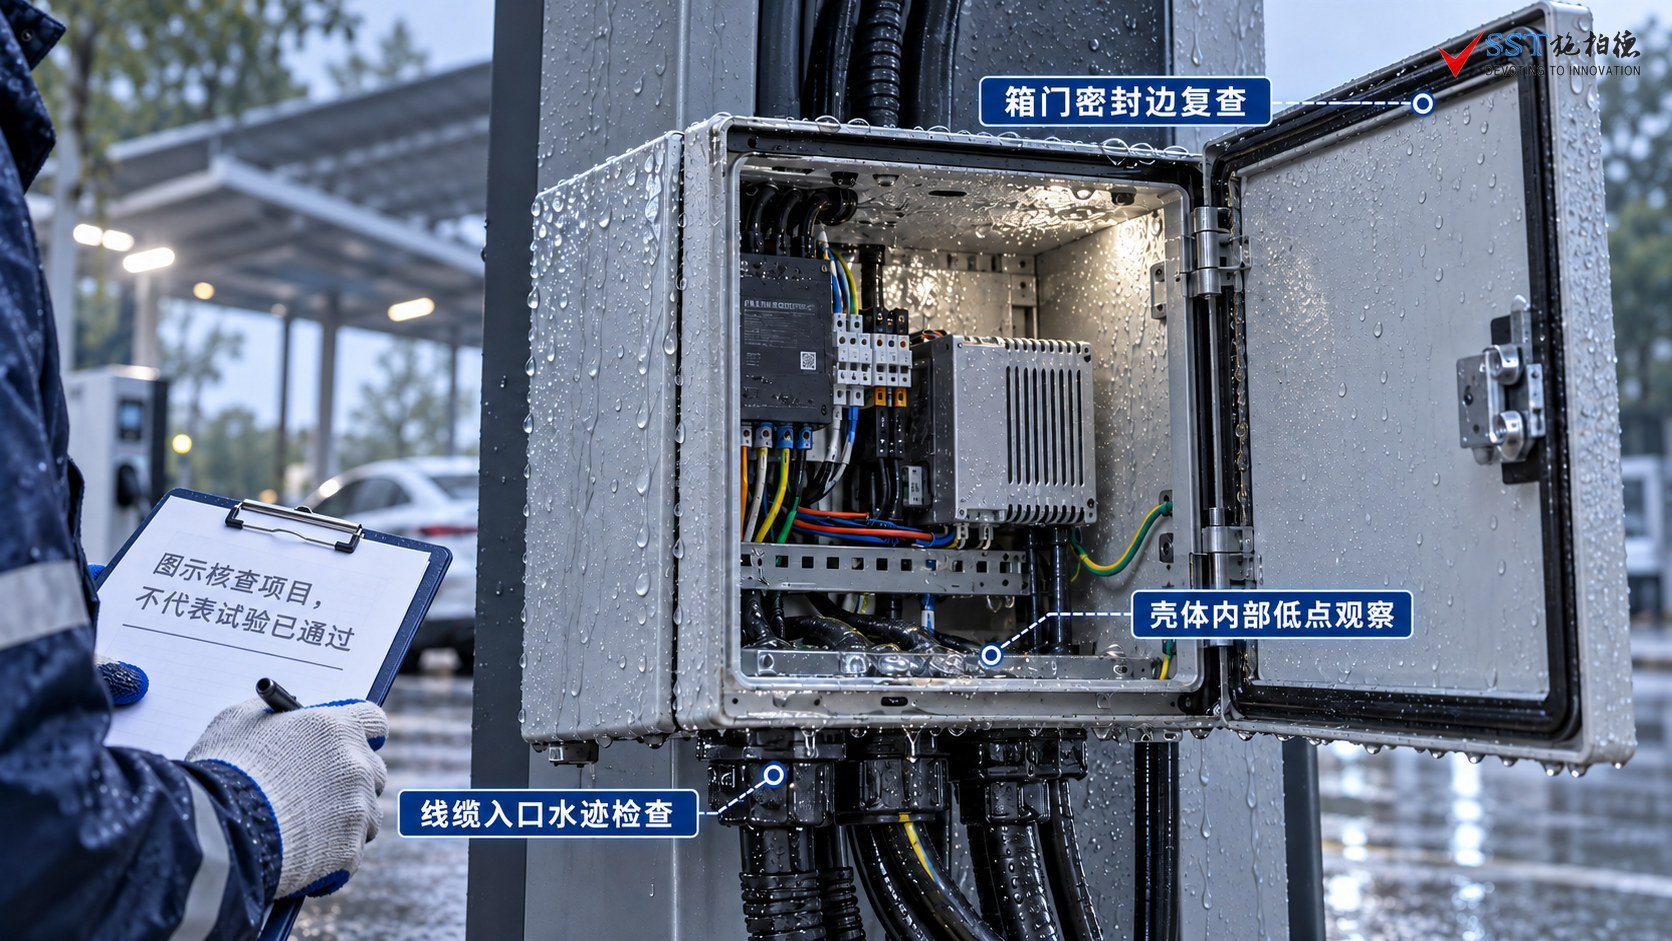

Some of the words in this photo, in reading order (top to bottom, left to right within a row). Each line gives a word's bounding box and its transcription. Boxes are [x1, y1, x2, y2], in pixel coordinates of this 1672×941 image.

[136, 586, 355, 652] 不代表试验已通过
